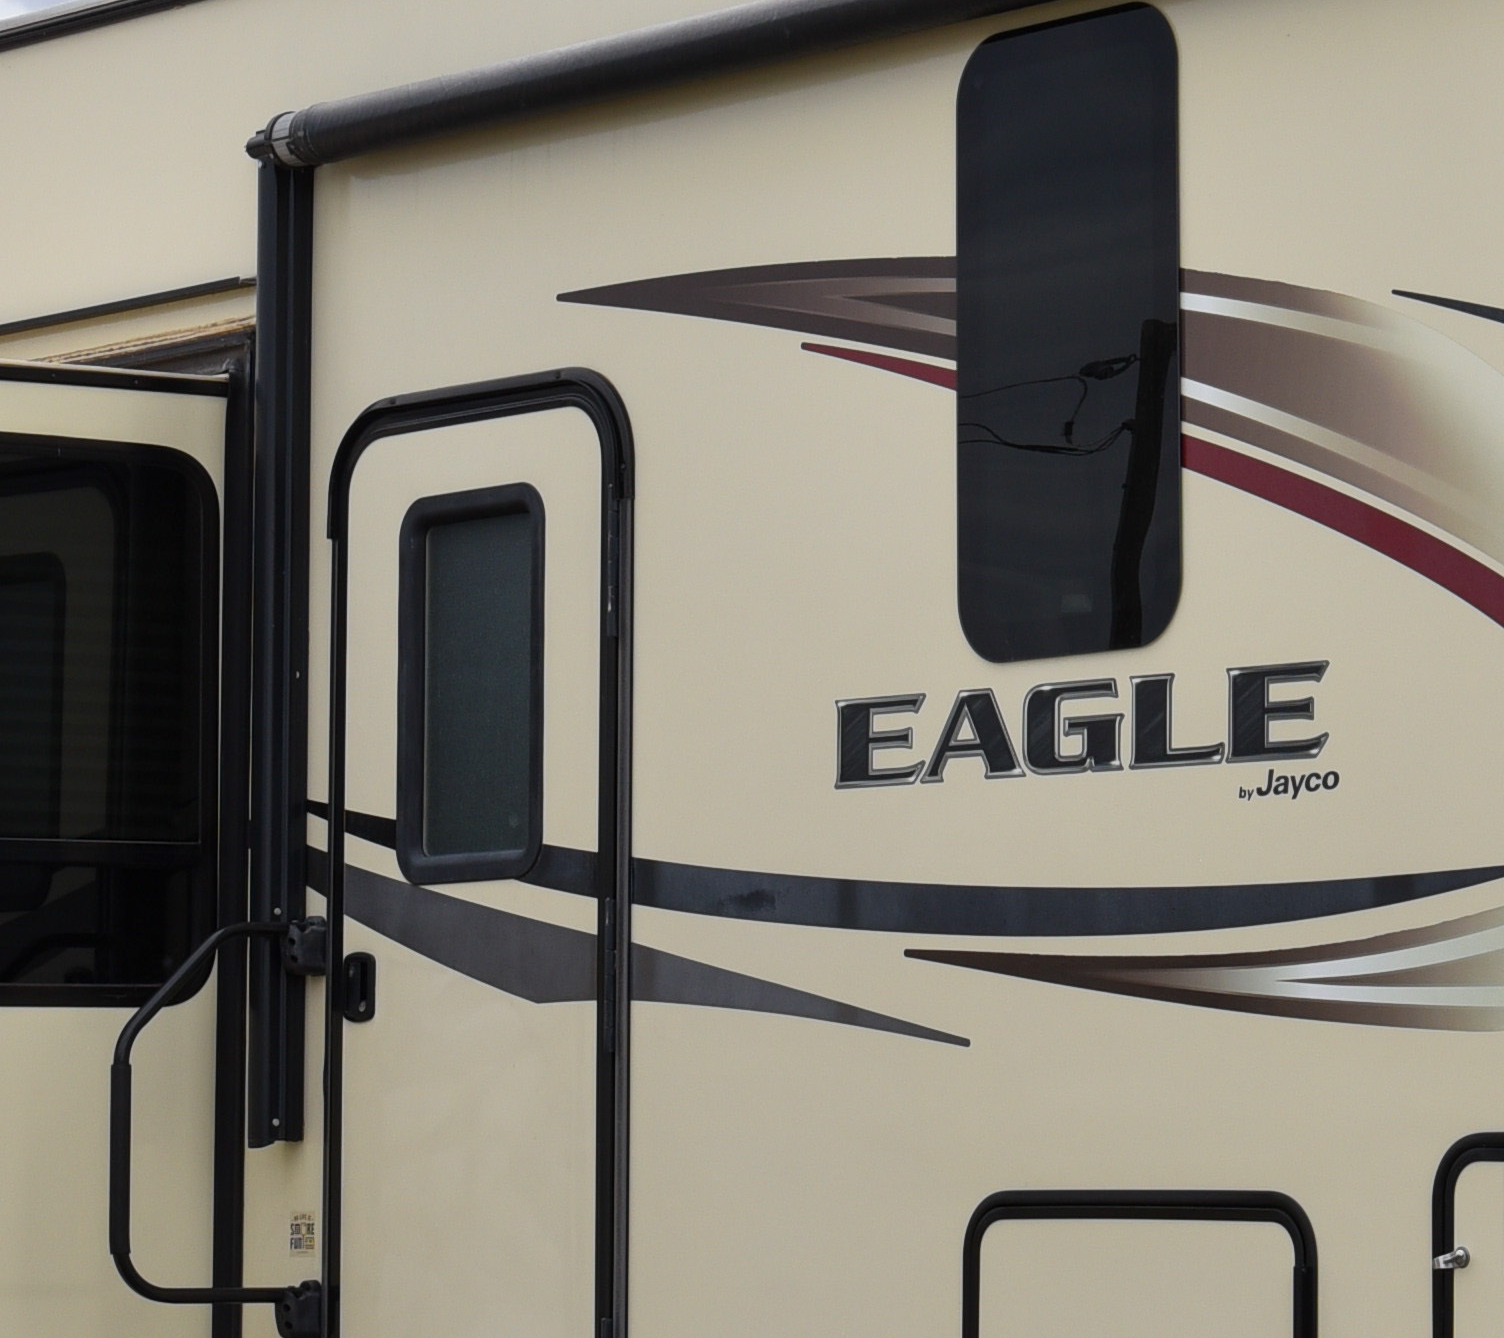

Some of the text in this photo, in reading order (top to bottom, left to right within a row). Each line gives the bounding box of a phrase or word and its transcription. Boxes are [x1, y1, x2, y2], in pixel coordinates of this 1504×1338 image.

[834, 660, 1330, 790] EAGLE
[1238, 768, 1340, 801] by Jayco
